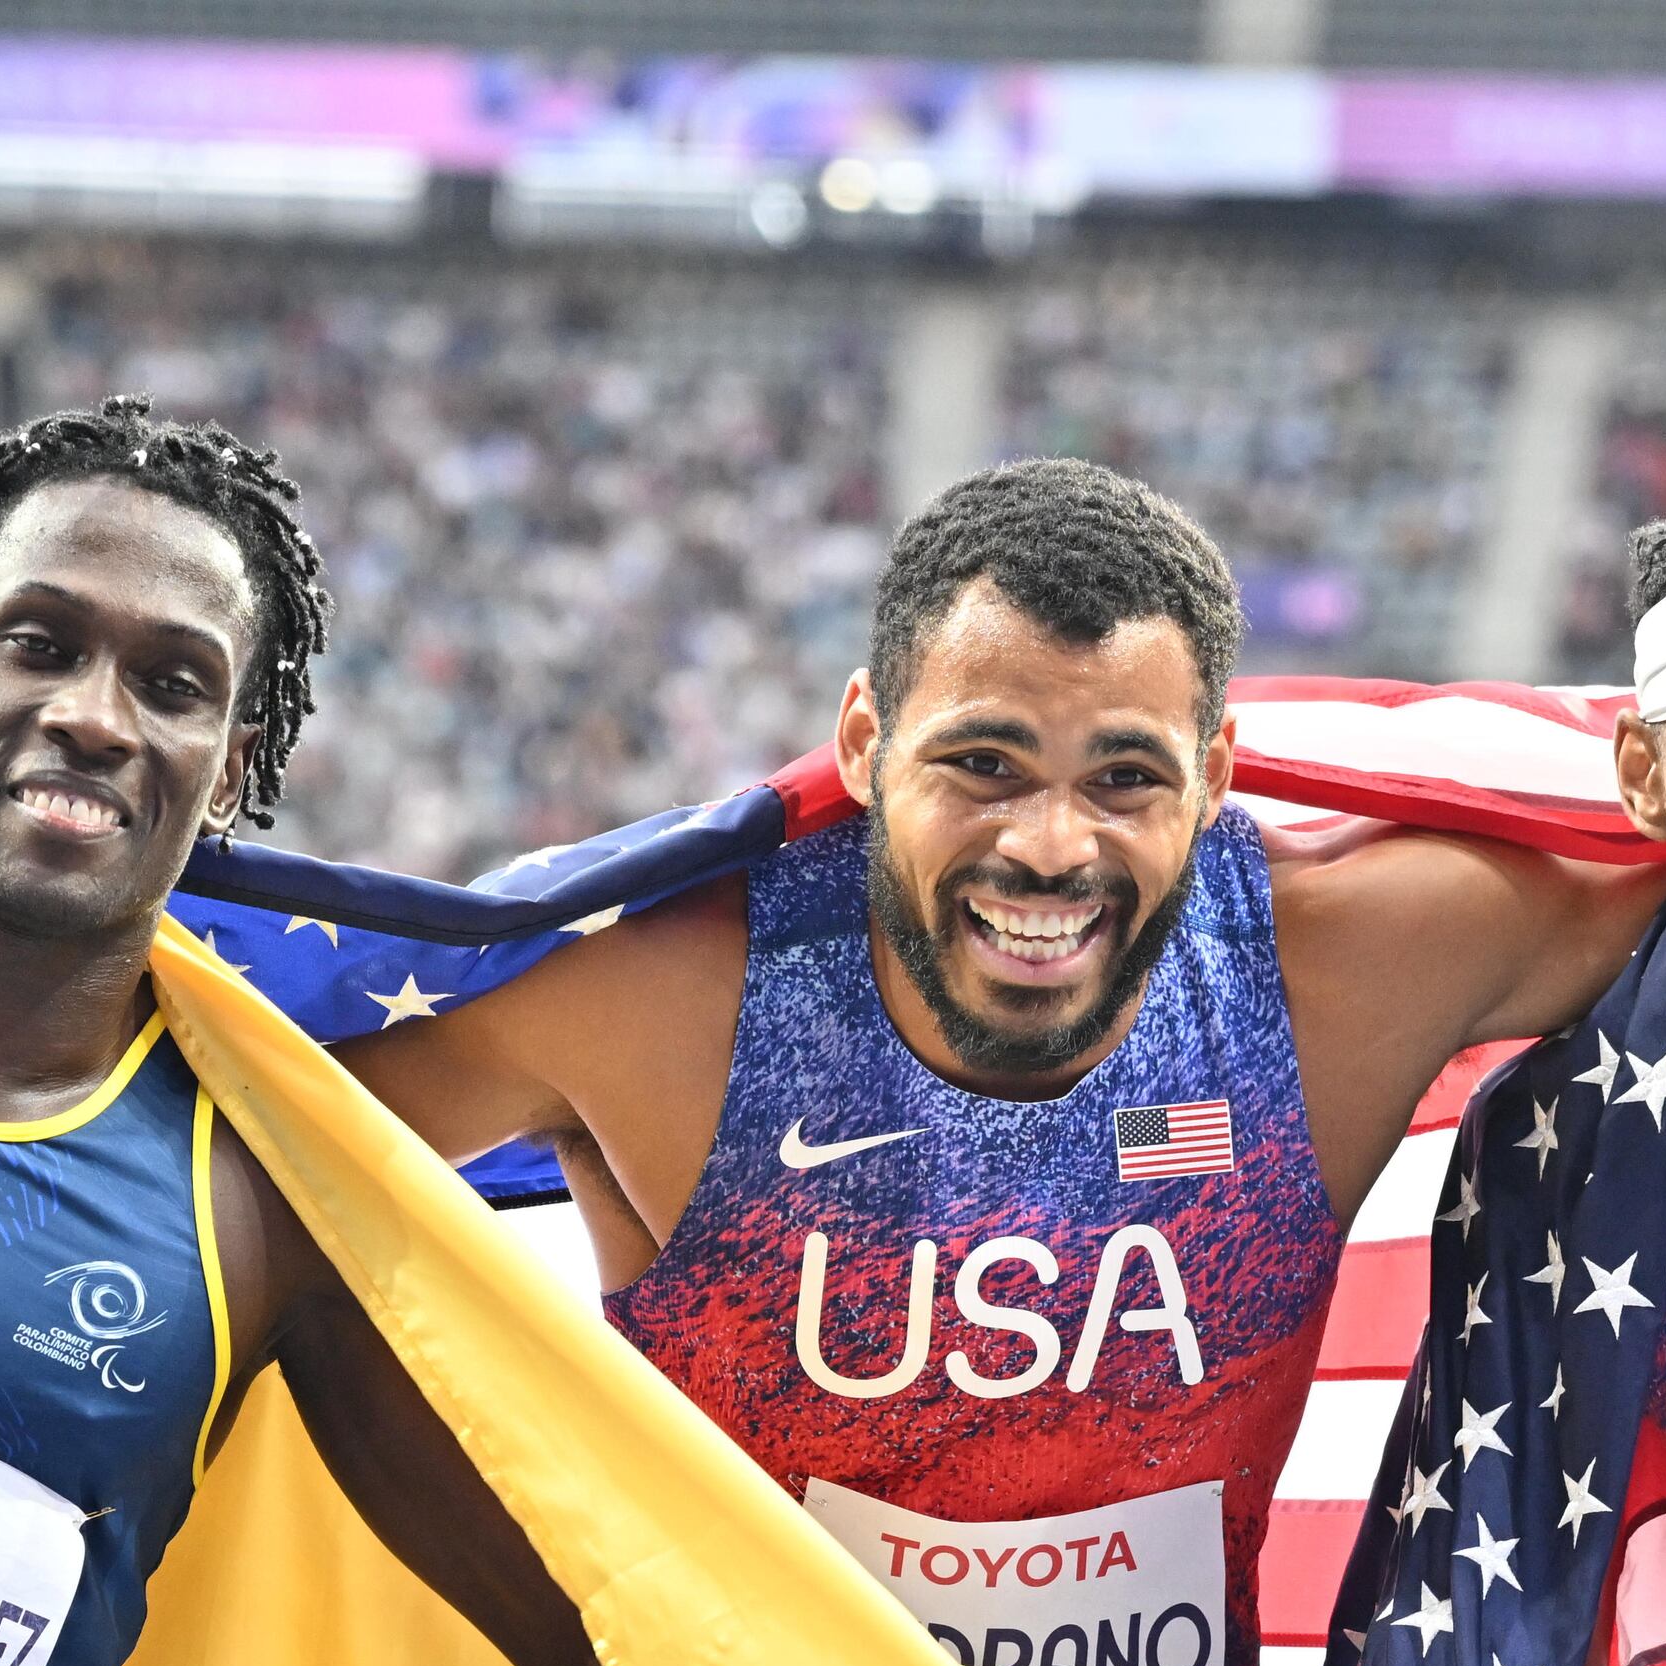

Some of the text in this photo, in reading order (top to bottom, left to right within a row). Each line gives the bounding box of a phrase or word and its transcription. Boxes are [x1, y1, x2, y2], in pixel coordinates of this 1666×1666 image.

[795, 1224, 1204, 1399] USA
[13, 1333, 86, 1371] COLOMBIANO
[16, 1323, 90, 1361] PARALÍMPICO
[50, 1327, 93, 1351] COMITÉ
[880, 1530, 1138, 1588] TOYOTA
